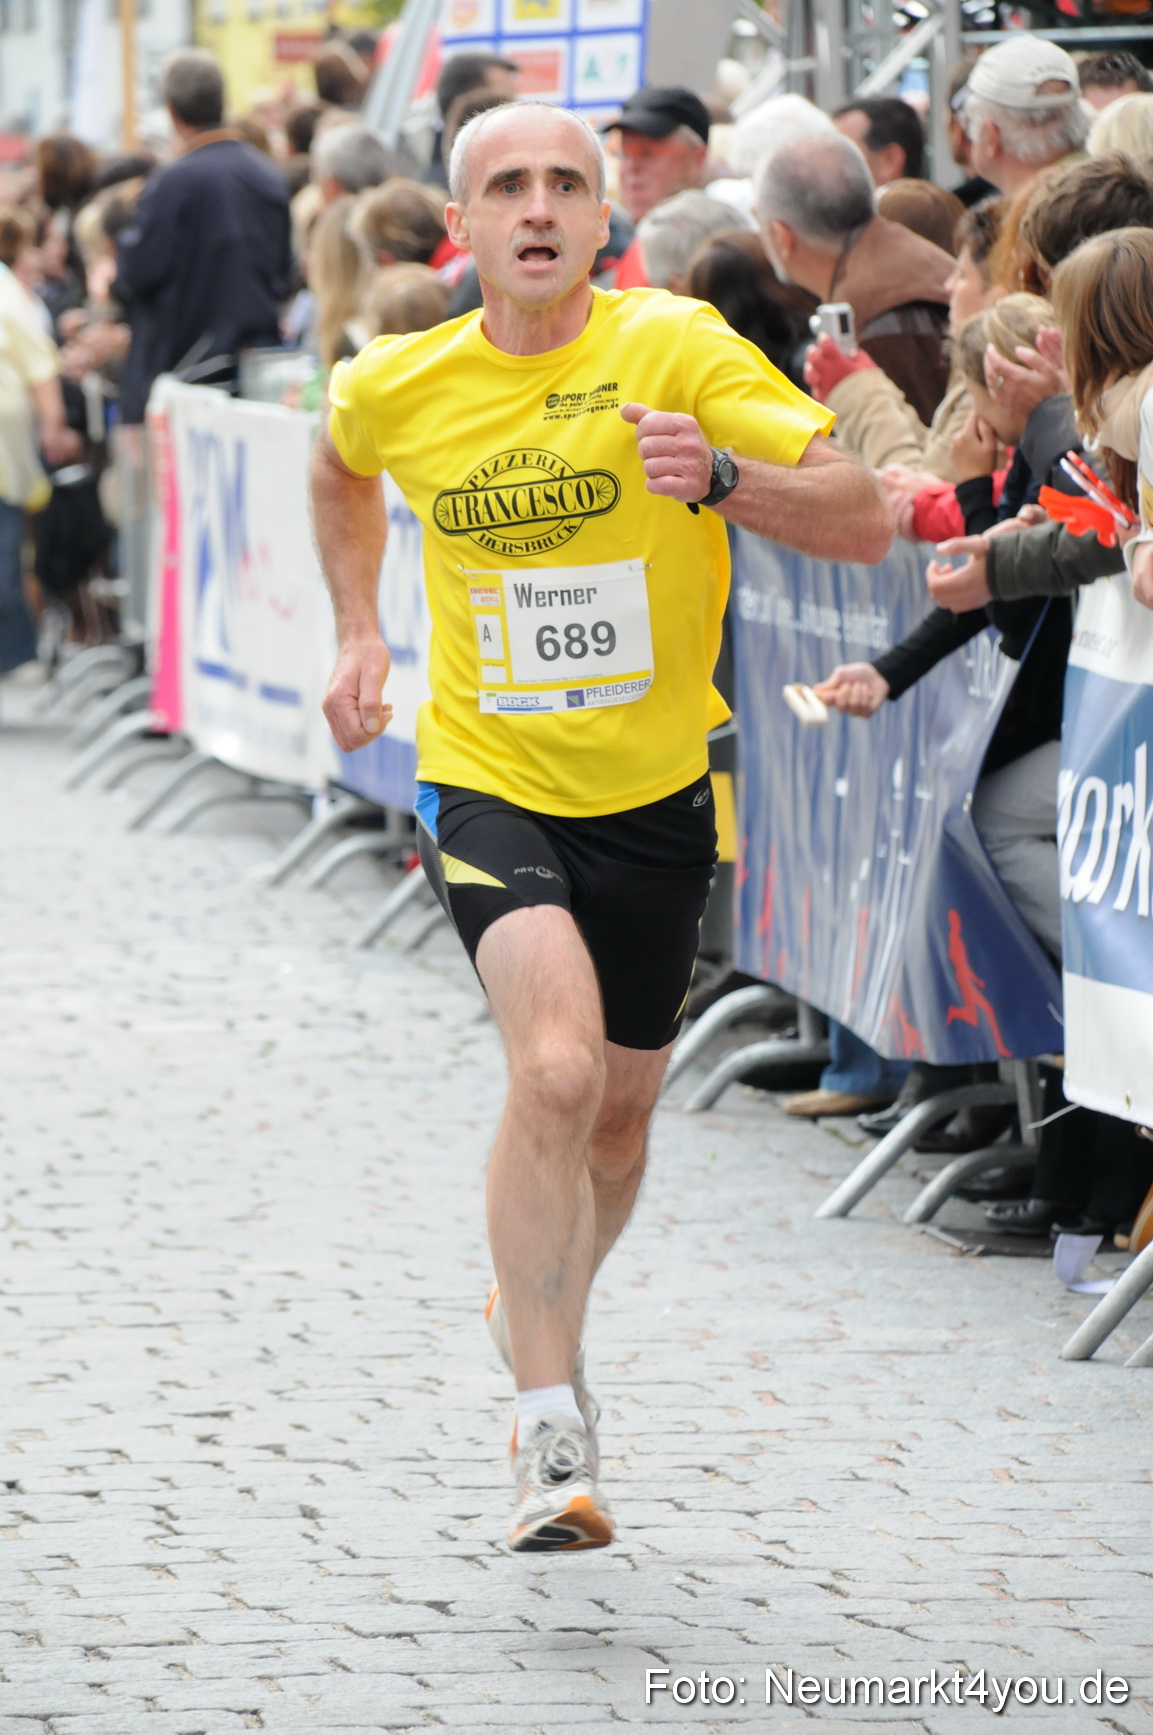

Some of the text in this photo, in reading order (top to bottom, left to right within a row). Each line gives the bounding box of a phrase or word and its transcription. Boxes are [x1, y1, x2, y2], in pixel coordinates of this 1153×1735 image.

[560, 391, 587, 402] SPORT
[469, 452, 567, 489] PIZZERIA
[451, 478, 596, 527] FRANCESCO
[478, 521, 579, 554] HERSBRUCK
[514, 583, 598, 609] Werner
[482, 623, 492, 643] A
[536, 620, 617, 662] 689
[496, 697, 540, 708] BOCK
[586, 679, 653, 699] PFLEIDERER
[1058, 741, 1153, 918] ark
